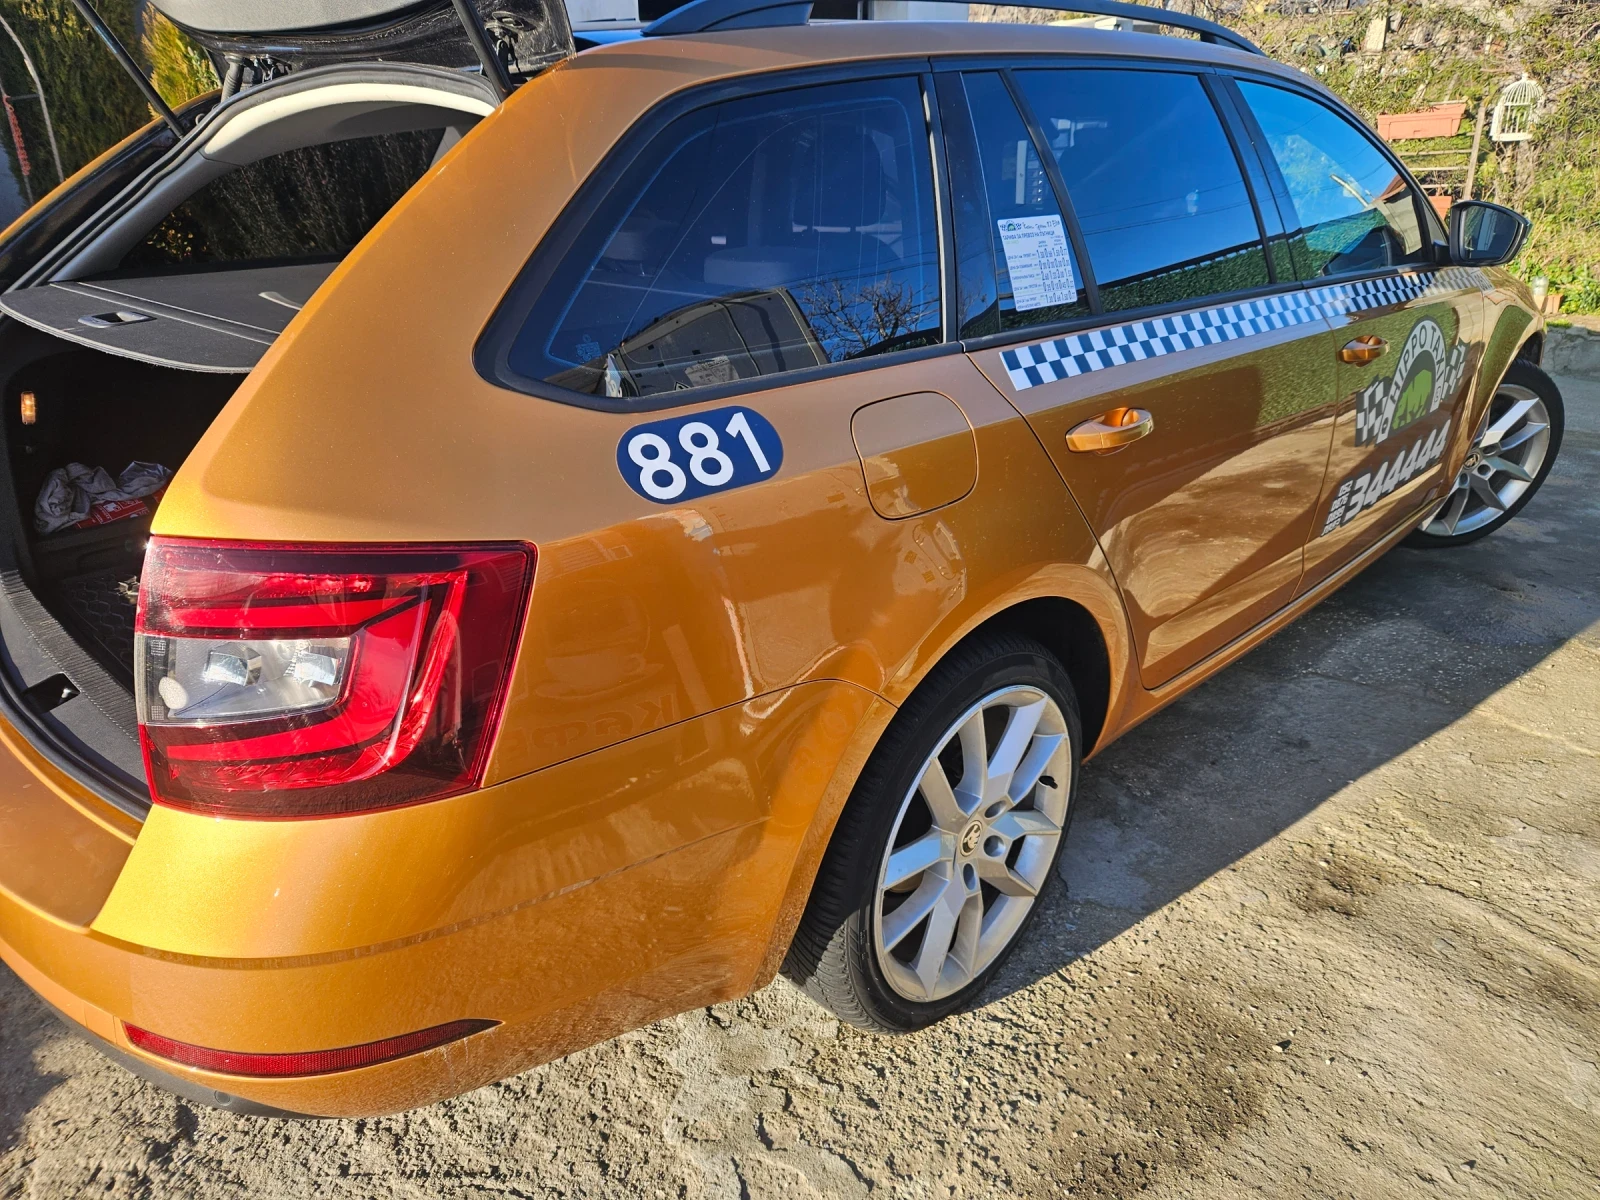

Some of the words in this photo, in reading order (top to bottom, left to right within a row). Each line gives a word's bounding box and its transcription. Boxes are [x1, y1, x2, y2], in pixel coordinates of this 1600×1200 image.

[1390, 327, 1428, 404] HIPPO
[1430, 326, 1447, 382] TAXI
[628, 411, 771, 500] 881
[1344, 419, 1452, 521] 344444
